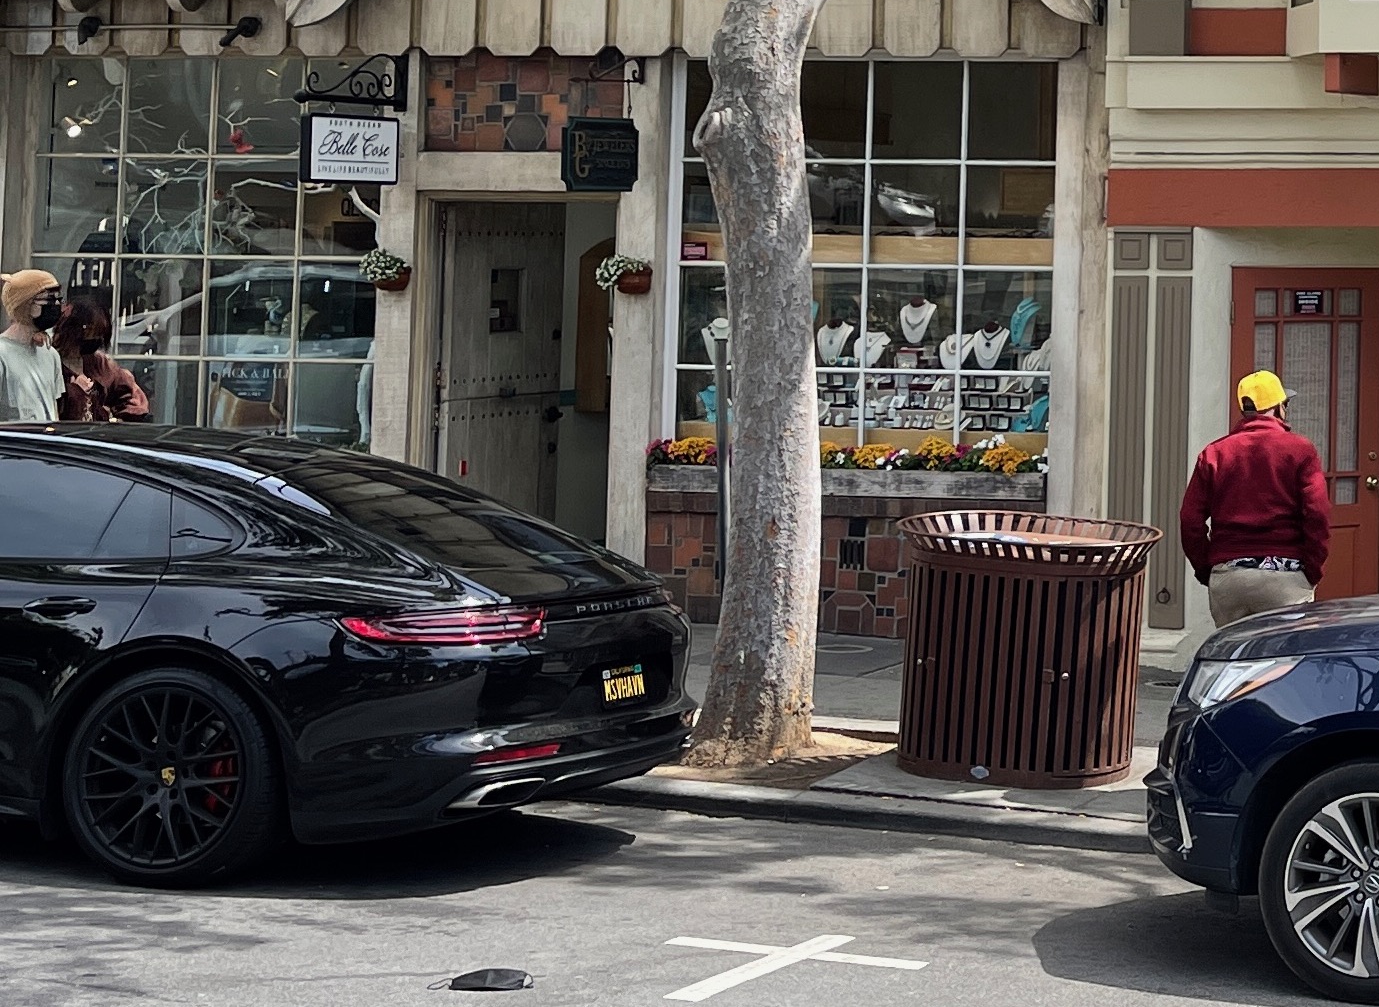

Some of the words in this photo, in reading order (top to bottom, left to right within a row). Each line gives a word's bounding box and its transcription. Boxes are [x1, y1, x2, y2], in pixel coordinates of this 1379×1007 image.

[318, 130, 360, 156] Belle
[362, 131, 391, 159] Cose
[575, 596, 653, 613] PORSCHE
